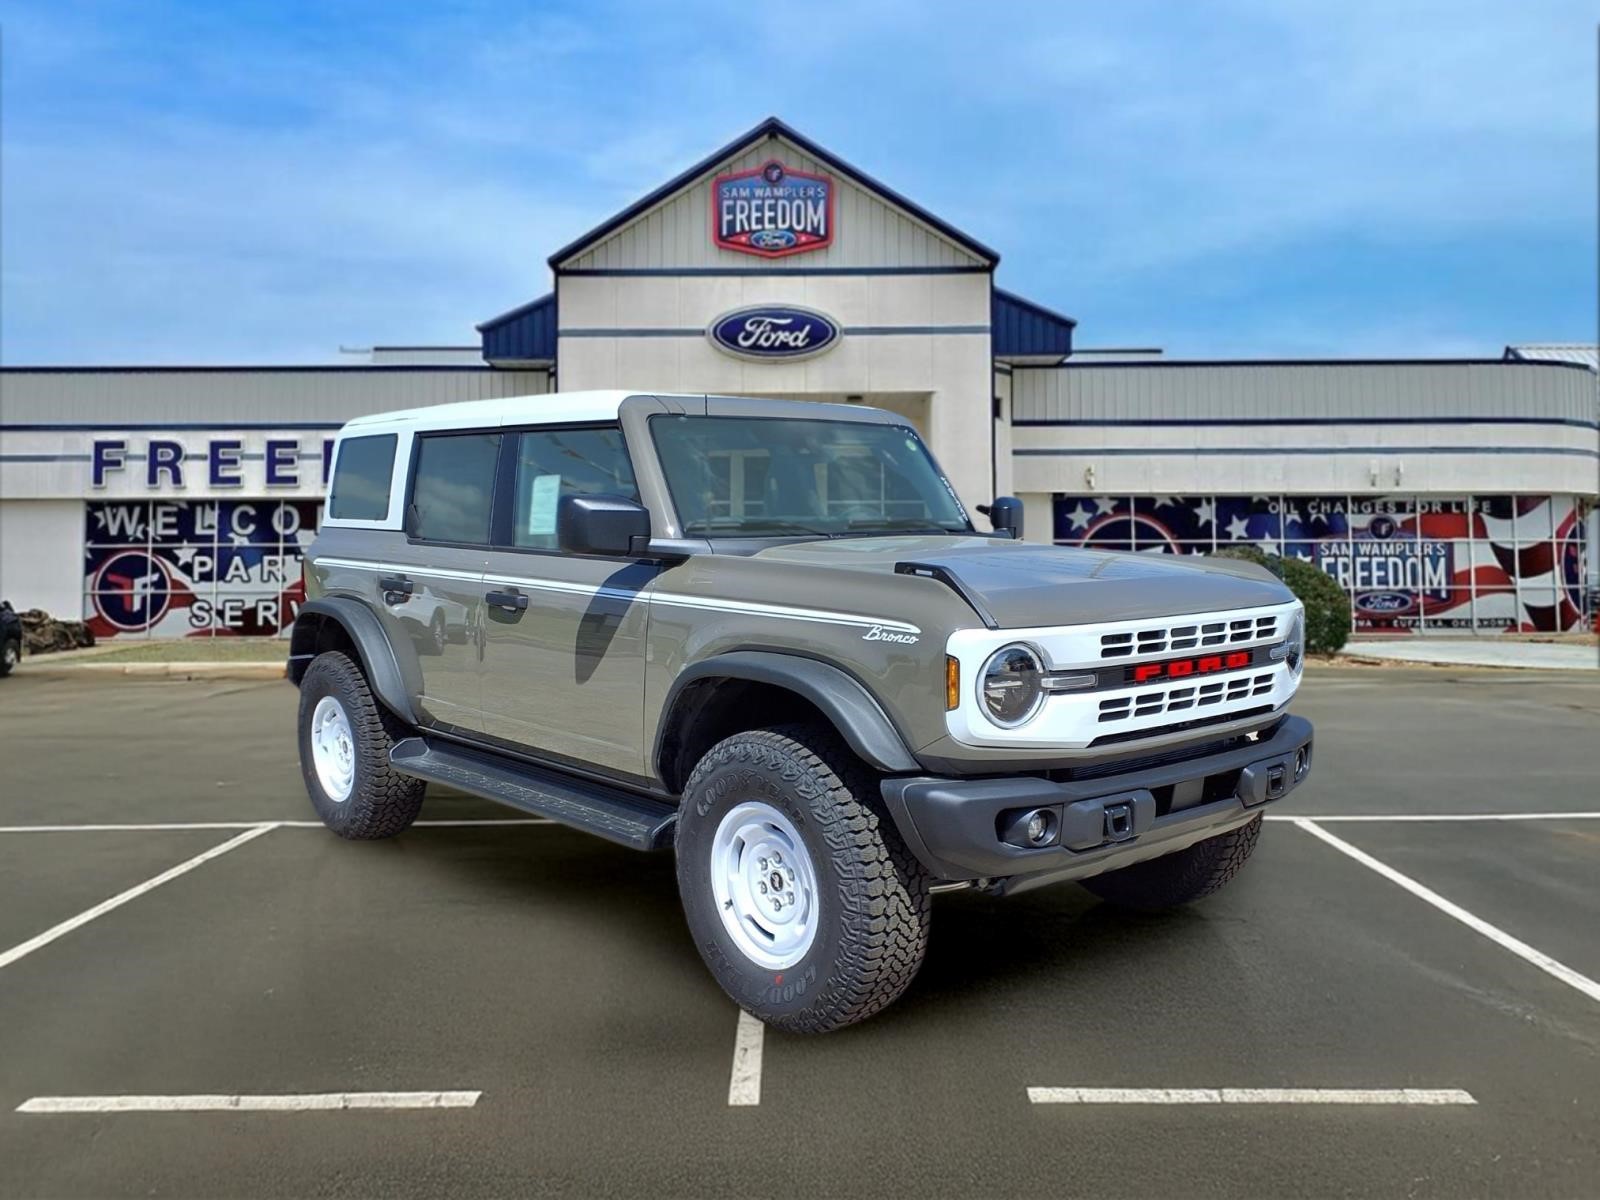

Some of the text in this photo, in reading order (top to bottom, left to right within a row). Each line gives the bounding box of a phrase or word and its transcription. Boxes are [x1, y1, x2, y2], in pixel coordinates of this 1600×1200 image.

[721, 187, 751, 198] SAM
[721, 199, 826, 236] FREEDOM
[758, 232, 788, 247] Ford
[736, 316, 811, 348] Ford
[92, 439, 336, 487] FREE
[104, 506, 326, 536] WELCO
[1268, 501, 1492, 515] OIL CHANGES FOR LIFE
[1365, 596, 1399, 610] Ford
[862, 624, 921, 646] Bronco
[1135, 651, 1251, 682] FORD
